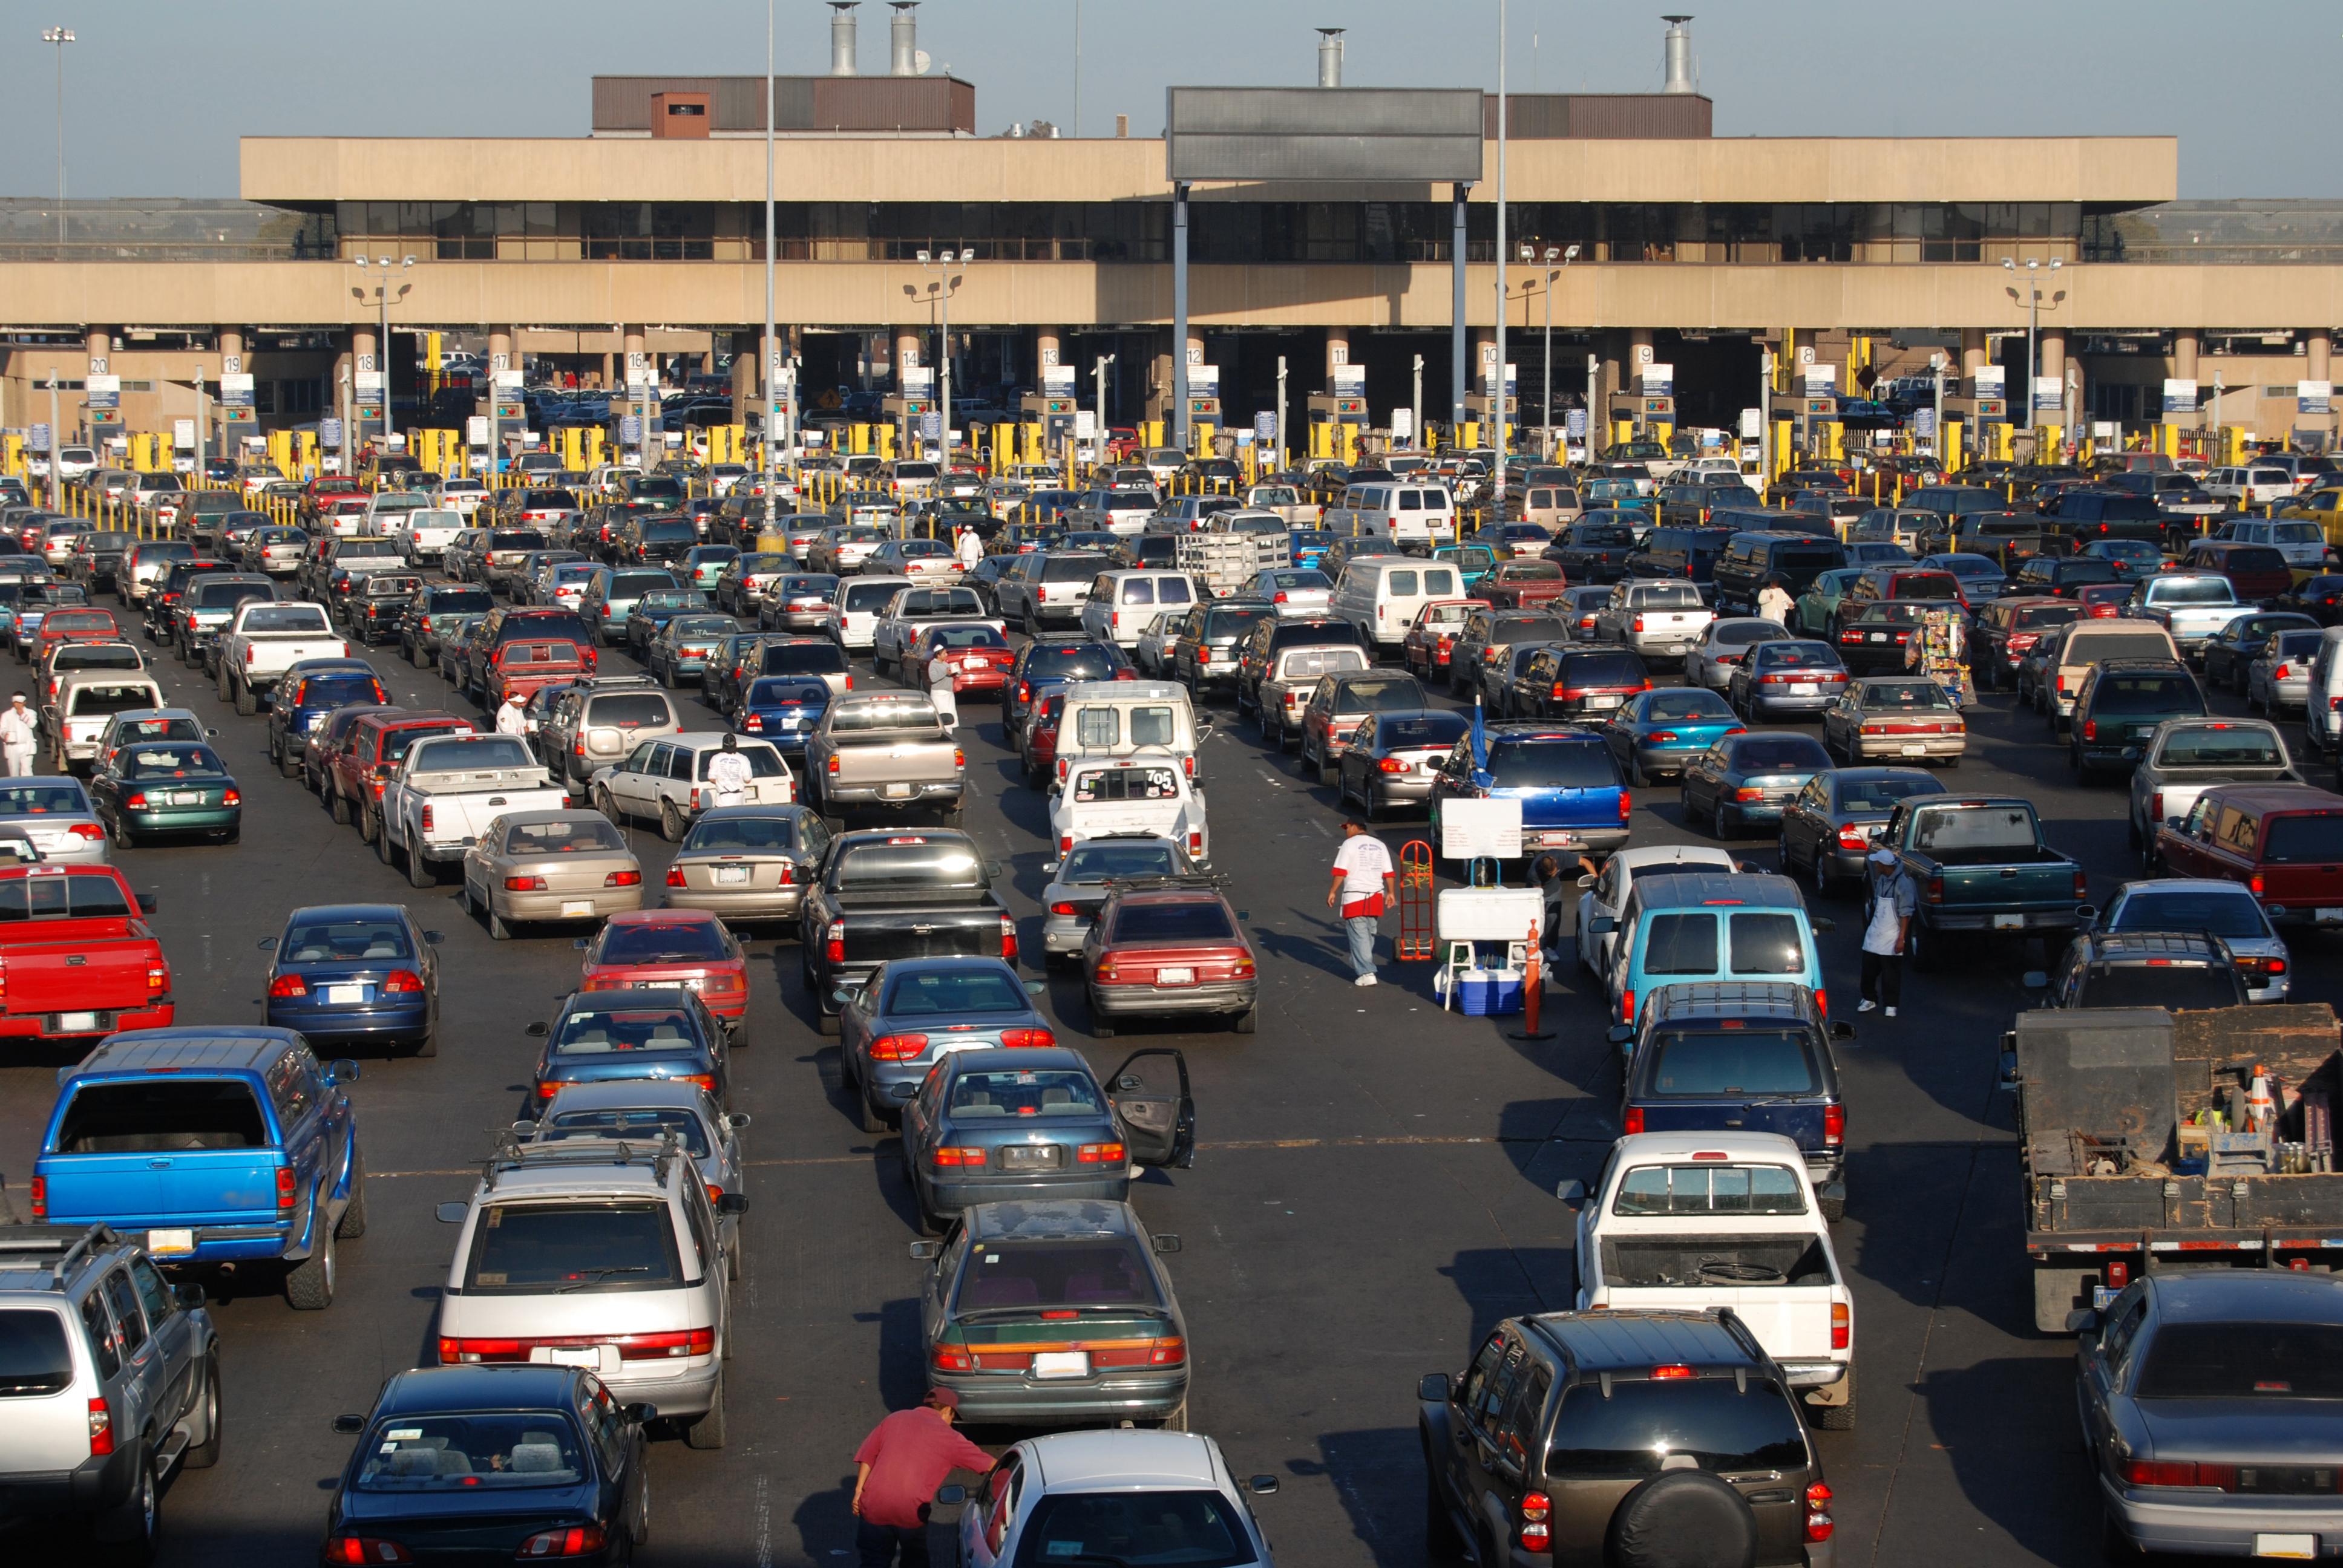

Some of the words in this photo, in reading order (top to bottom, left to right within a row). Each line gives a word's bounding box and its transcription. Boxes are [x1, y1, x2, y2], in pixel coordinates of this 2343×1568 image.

[494, 354, 506, 368] 17
[629, 353, 643, 367] 16
[903, 351, 917, 365] 14
[1044, 350, 1058, 364] 13
[1187, 349, 1201, 363] 12
[1334, 349, 1345, 363] 11
[1484, 348, 1496, 362] 10
[1642, 348, 1651, 362] 9
[1804, 348, 1813, 362] 8
[93, 359, 106, 373] 20
[226, 358, 240, 371] 19
[359, 356, 373, 370] 18
[1146, 770, 1172, 789] 705
